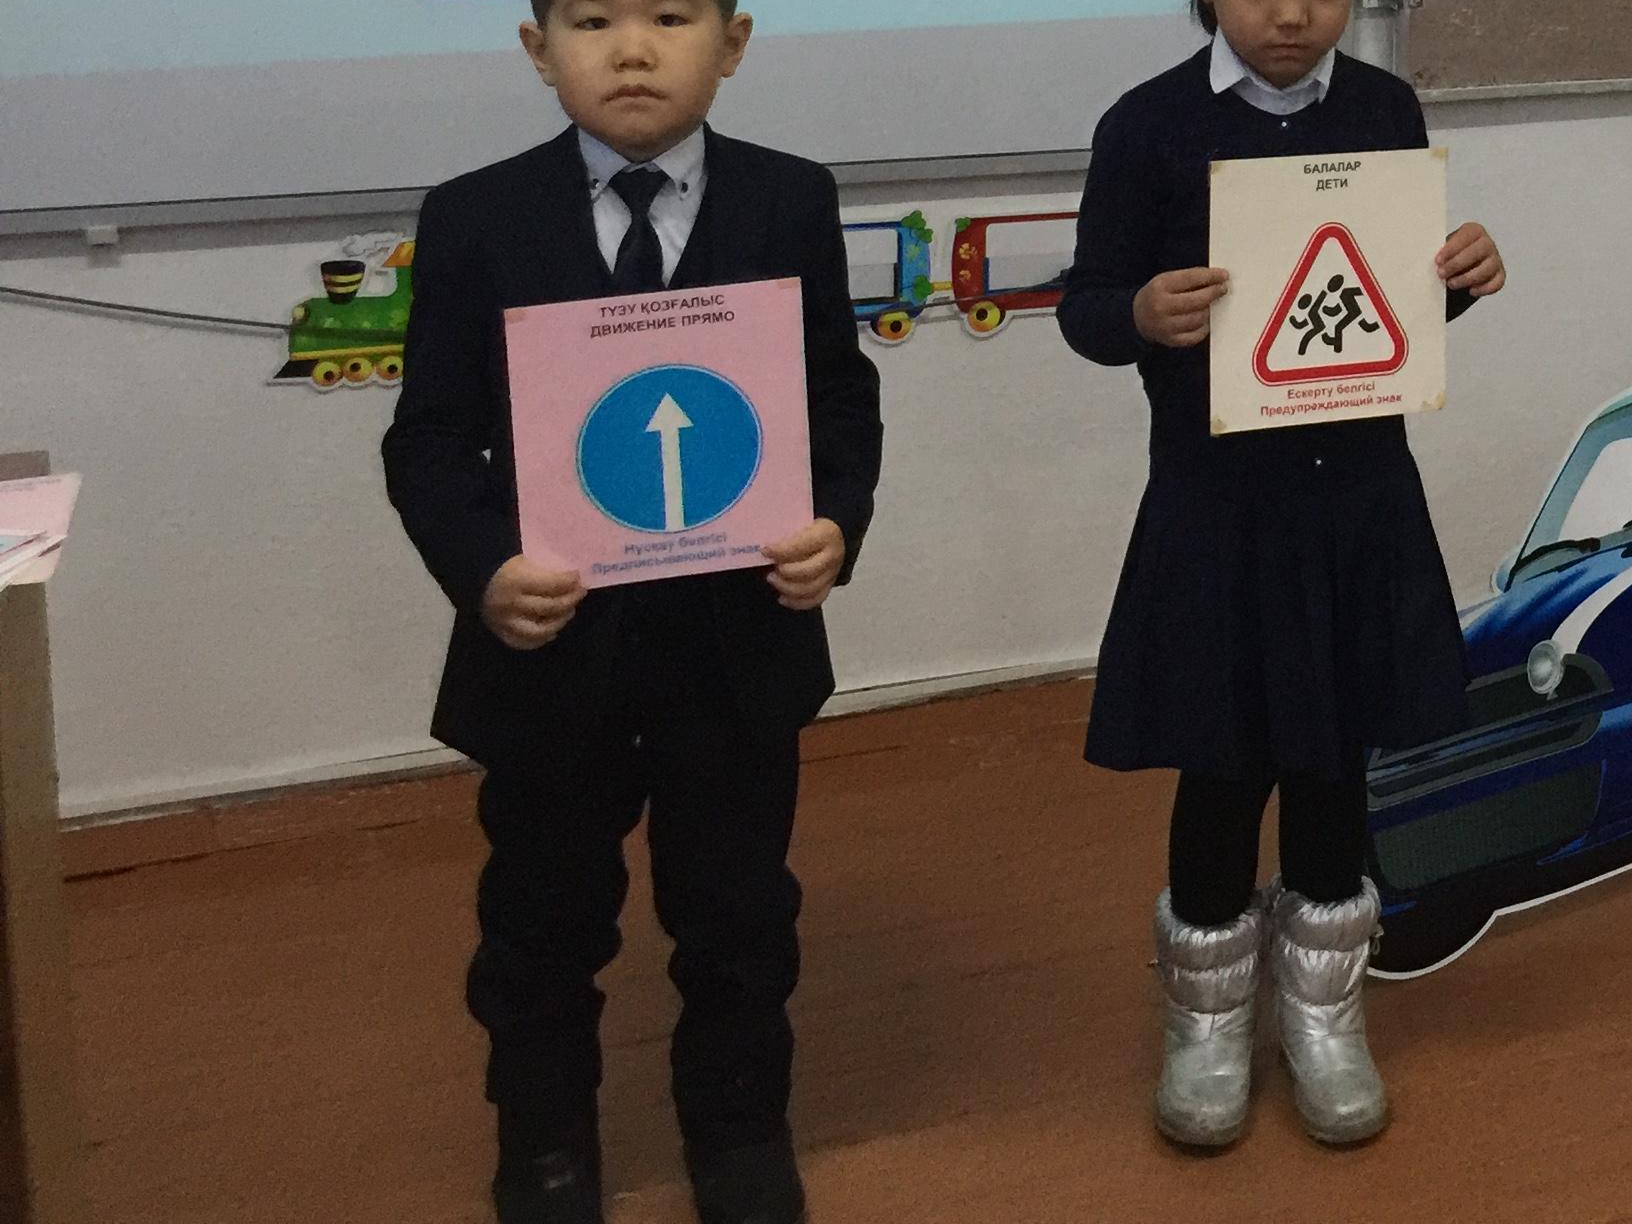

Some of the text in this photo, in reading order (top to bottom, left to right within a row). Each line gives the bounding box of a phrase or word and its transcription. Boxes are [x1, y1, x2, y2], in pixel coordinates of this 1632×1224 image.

[1304, 161, 1362, 175] БАЛАЛАР
[1315, 178, 1349, 192] ДЕТИ
[600, 304, 637, 319] ТҮЗУ
[589, 310, 736, 339] ДВИЖЕНИЕ ПРЯМО
[1287, 381, 1377, 401] Ескерту белгісі
[1260, 393, 1403, 418] Предупреждающий знак
